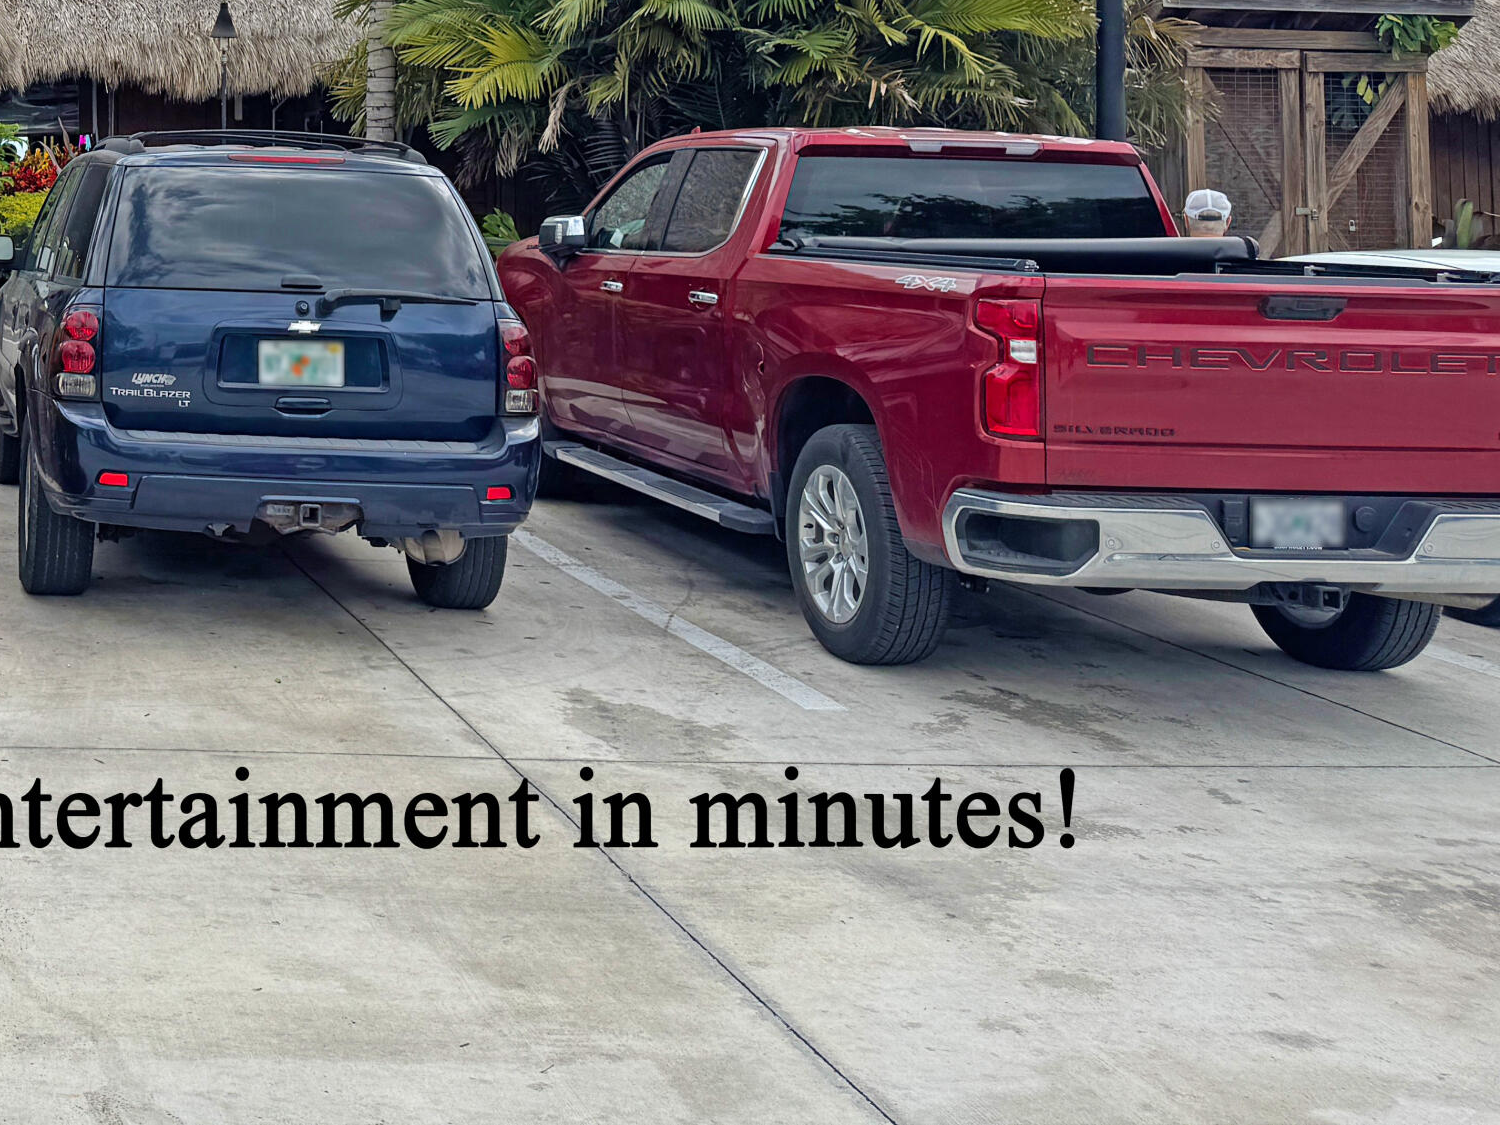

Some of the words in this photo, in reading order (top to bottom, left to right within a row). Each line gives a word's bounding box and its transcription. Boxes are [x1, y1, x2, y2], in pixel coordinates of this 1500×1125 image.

[1085, 344, 1500, 376] CHEVROLET
[131, 372, 167, 384] LYNCH
[178, 399, 191, 408] LT
[1053, 424, 1176, 437] SILVERADO
